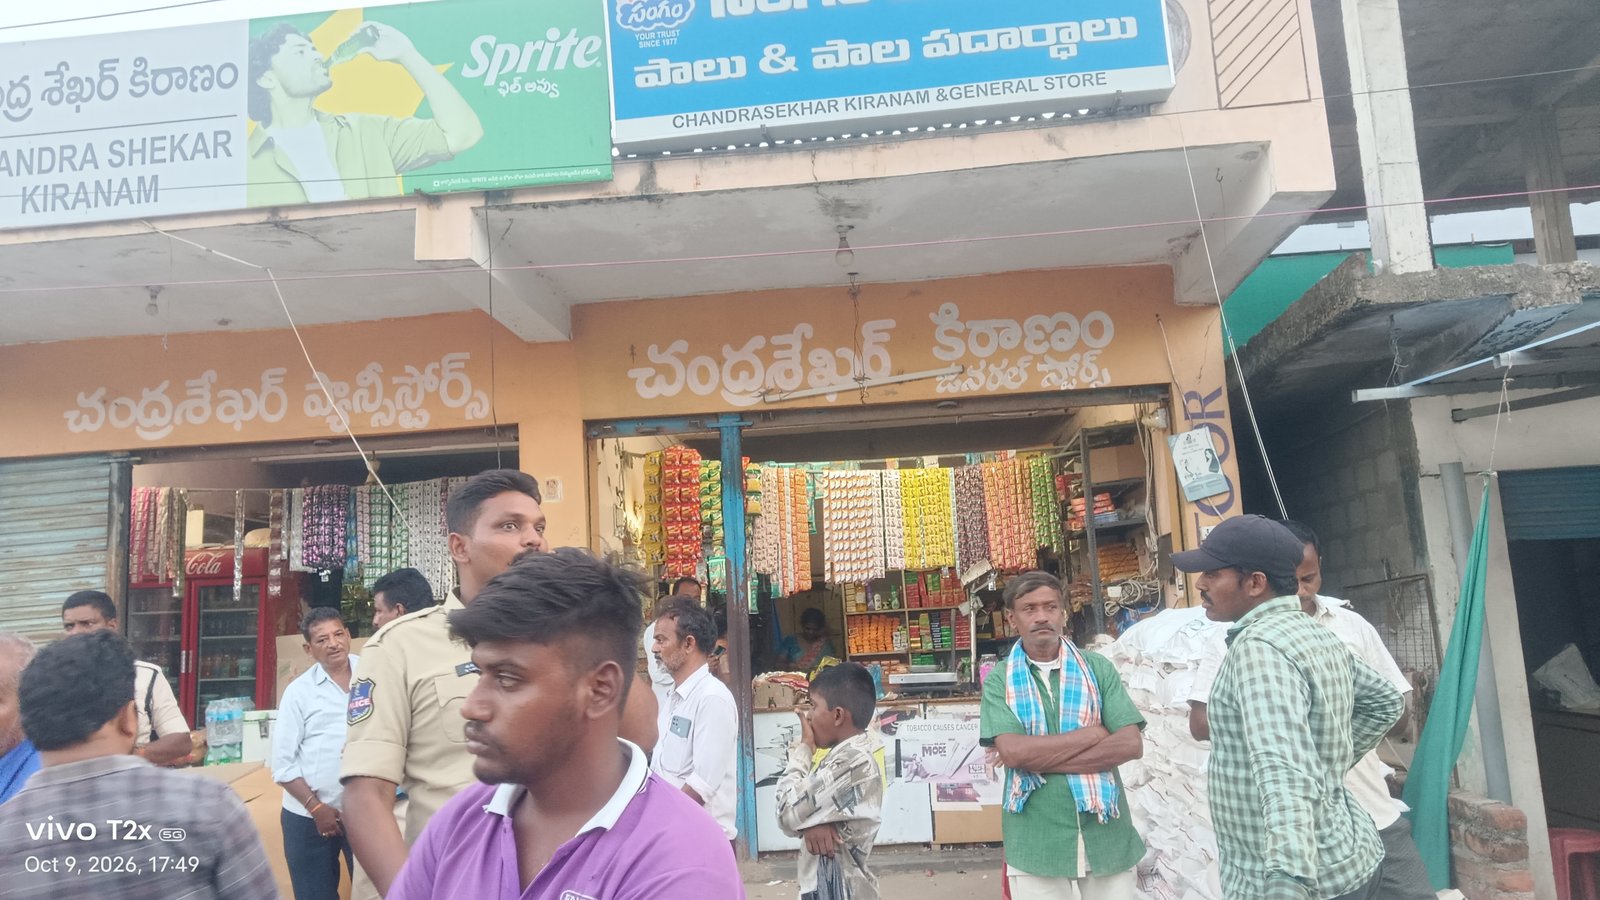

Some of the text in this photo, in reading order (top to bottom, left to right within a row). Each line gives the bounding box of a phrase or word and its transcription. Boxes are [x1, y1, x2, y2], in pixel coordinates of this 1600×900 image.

[461, 27, 602, 86] Sprite
[635, 29, 681, 41] YOUR TRUST
[639, 38, 678, 48] SINCE 1977
[41, 58, 119, 113] శేఖర్
[129, 56, 239, 98] కిరాణం
[634, 56, 747, 88] పాలు
[758, 43, 799, 74] &
[811, 39, 910, 70] పాల
[672, 99, 839, 129] CHANDRASEKHAR
[845, 90, 930, 111] KIRANAM
[1043, 72, 1108, 91] STORE
[108, 130, 233, 168] SHEKAR
[21, 174, 159, 214] KIRANAM
[929, 302, 1115, 361] కిరాణం
[907, 724, 931, 732] TOBACCO
[933, 723, 954, 731] CAUSES
